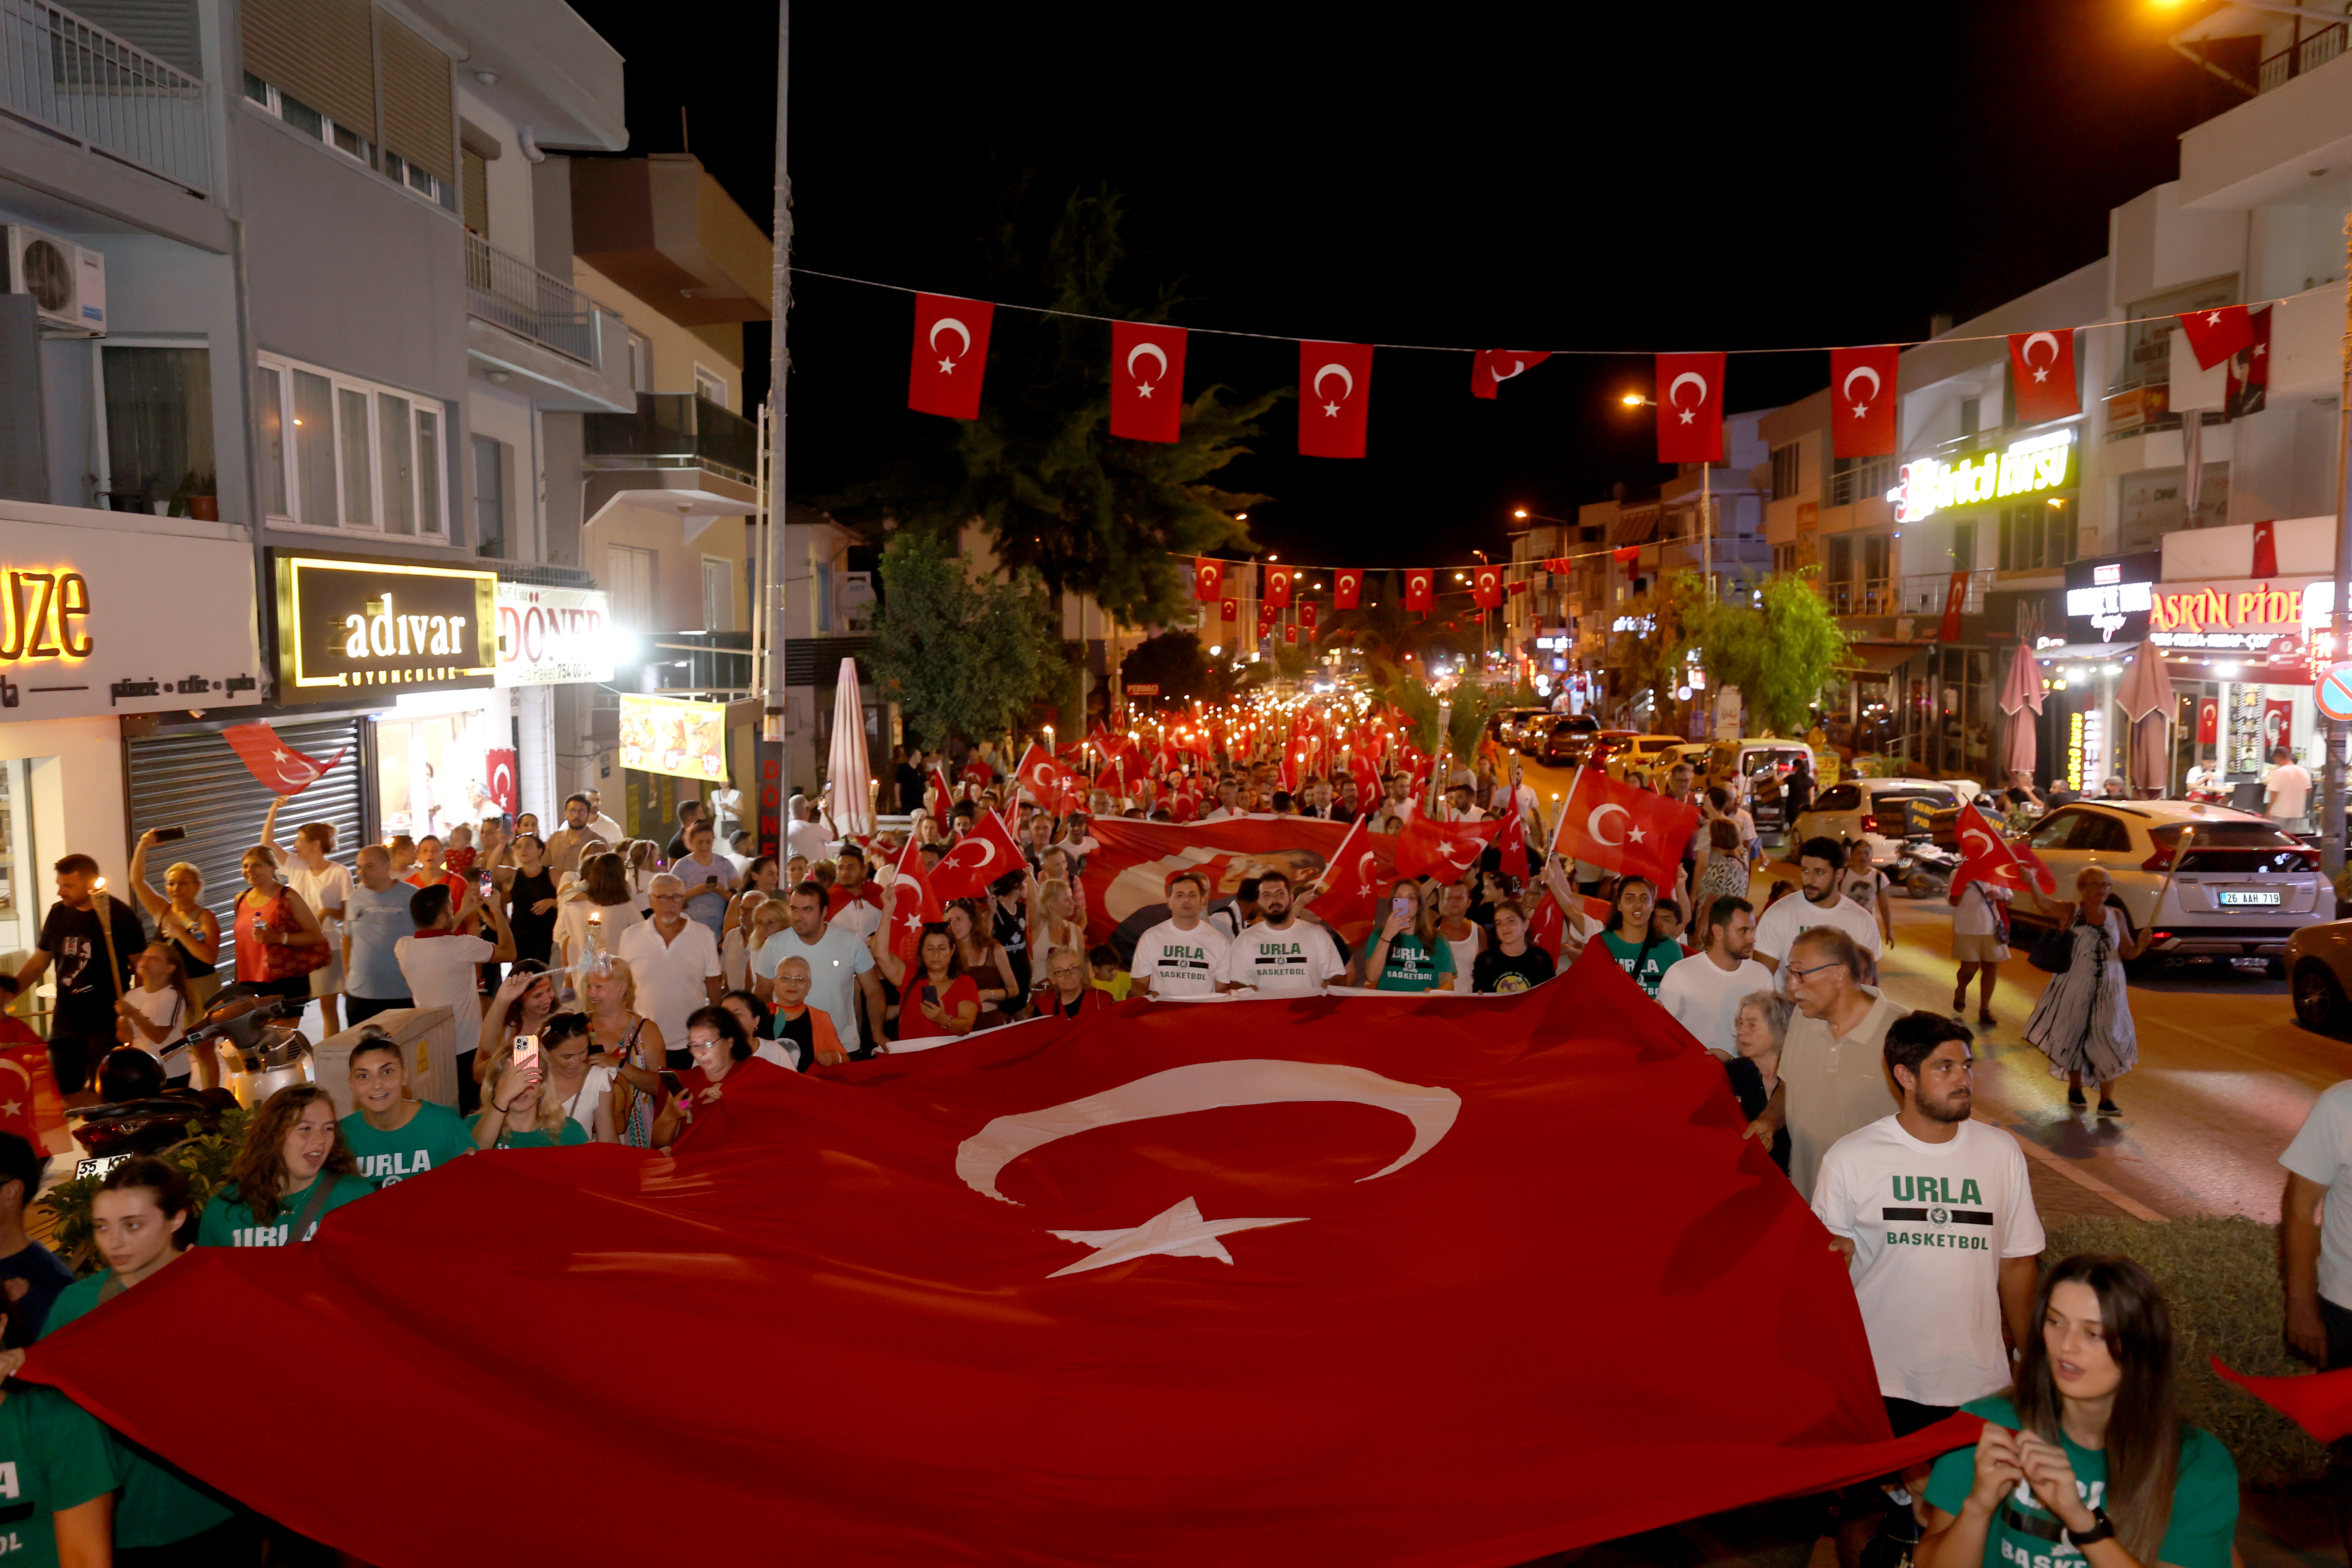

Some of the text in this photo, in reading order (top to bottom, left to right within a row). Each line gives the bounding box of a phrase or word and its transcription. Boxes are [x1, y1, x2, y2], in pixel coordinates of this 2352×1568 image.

[2236, 582, 2303, 625] PİDE
[346, 592, 466, 658] adıvar
[339, 666, 456, 687] KUYUMCULUK
[534, 664, 556, 680] Paket
[557, 663, 571, 679] 754
[762, 760, 780, 856] DÖNE
[2227, 894, 2279, 903] 26 AAH 719
[1164, 945, 1205, 960] URLA
[1260, 943, 1302, 955] URLA
[1392, 946, 1430, 961] URLA
[1161, 971, 1207, 980] BASKETBOL
[1387, 971, 1433, 980] BASKETBOL
[79, 1160, 98, 1174] 35
[356, 1149, 431, 1178] URLA
[1893, 1175, 1982, 1205] URLA
[1887, 1231, 1988, 1250] BASKETBOL
